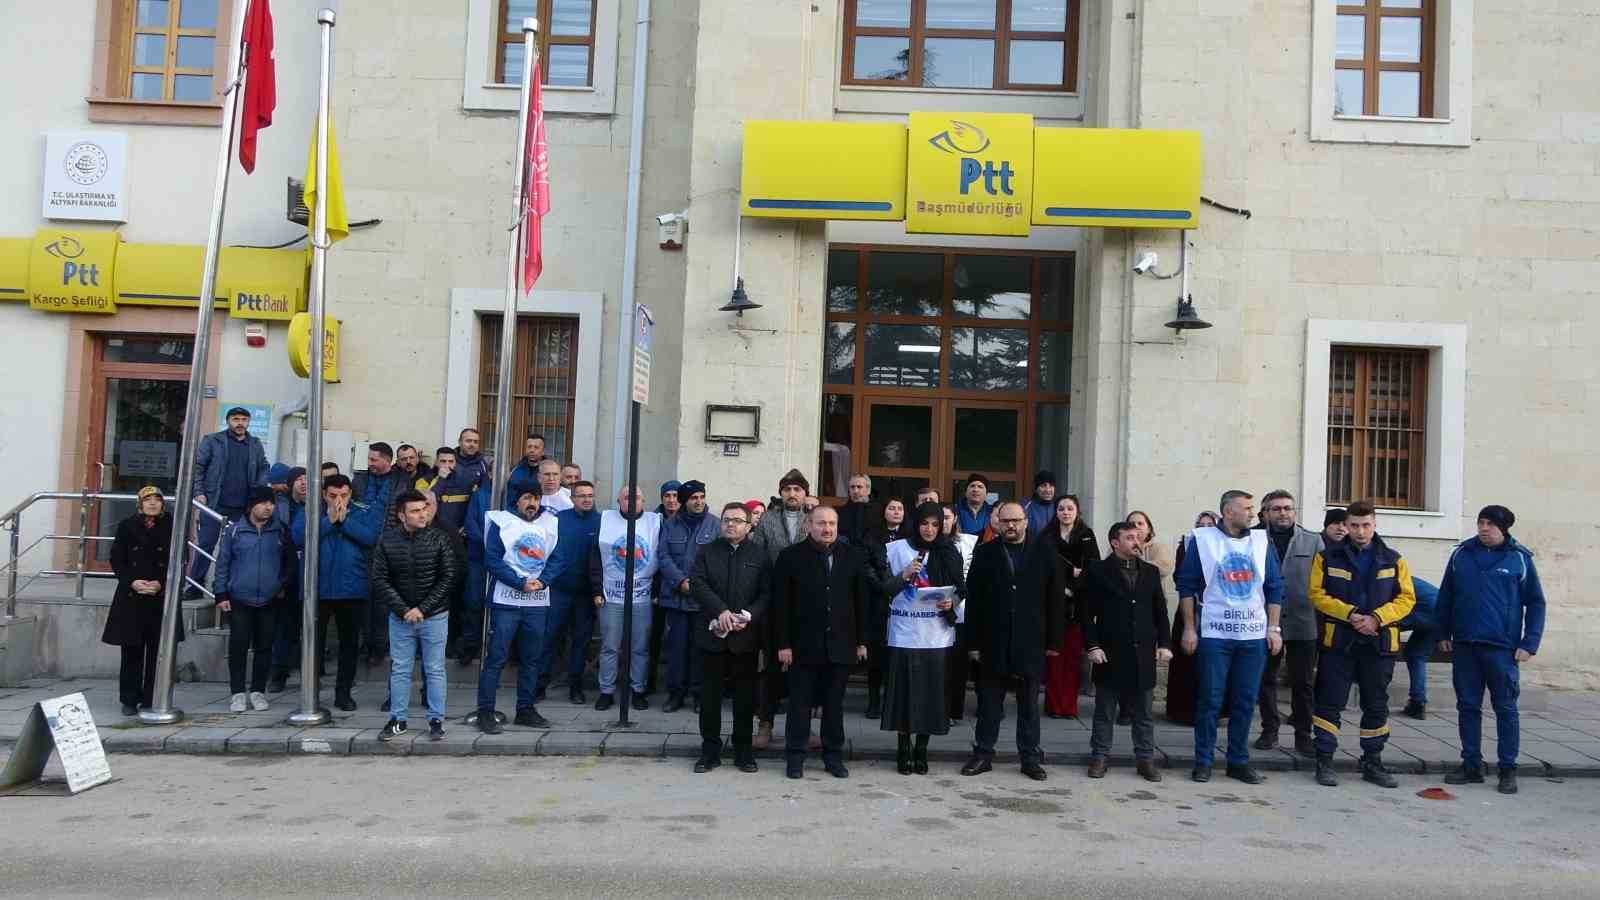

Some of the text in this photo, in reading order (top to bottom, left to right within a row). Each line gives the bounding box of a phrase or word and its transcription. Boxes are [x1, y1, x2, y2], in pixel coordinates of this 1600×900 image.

[960, 158, 1014, 195] Ptt
[916, 200, 1024, 217] Başmüdürlüğü
[63, 261, 99, 286] Ptt
[33, 294, 68, 306] Kargo
[1223, 608, 1255, 620] BİRLİK
[1209, 622, 1265, 633] HABER-SEN
